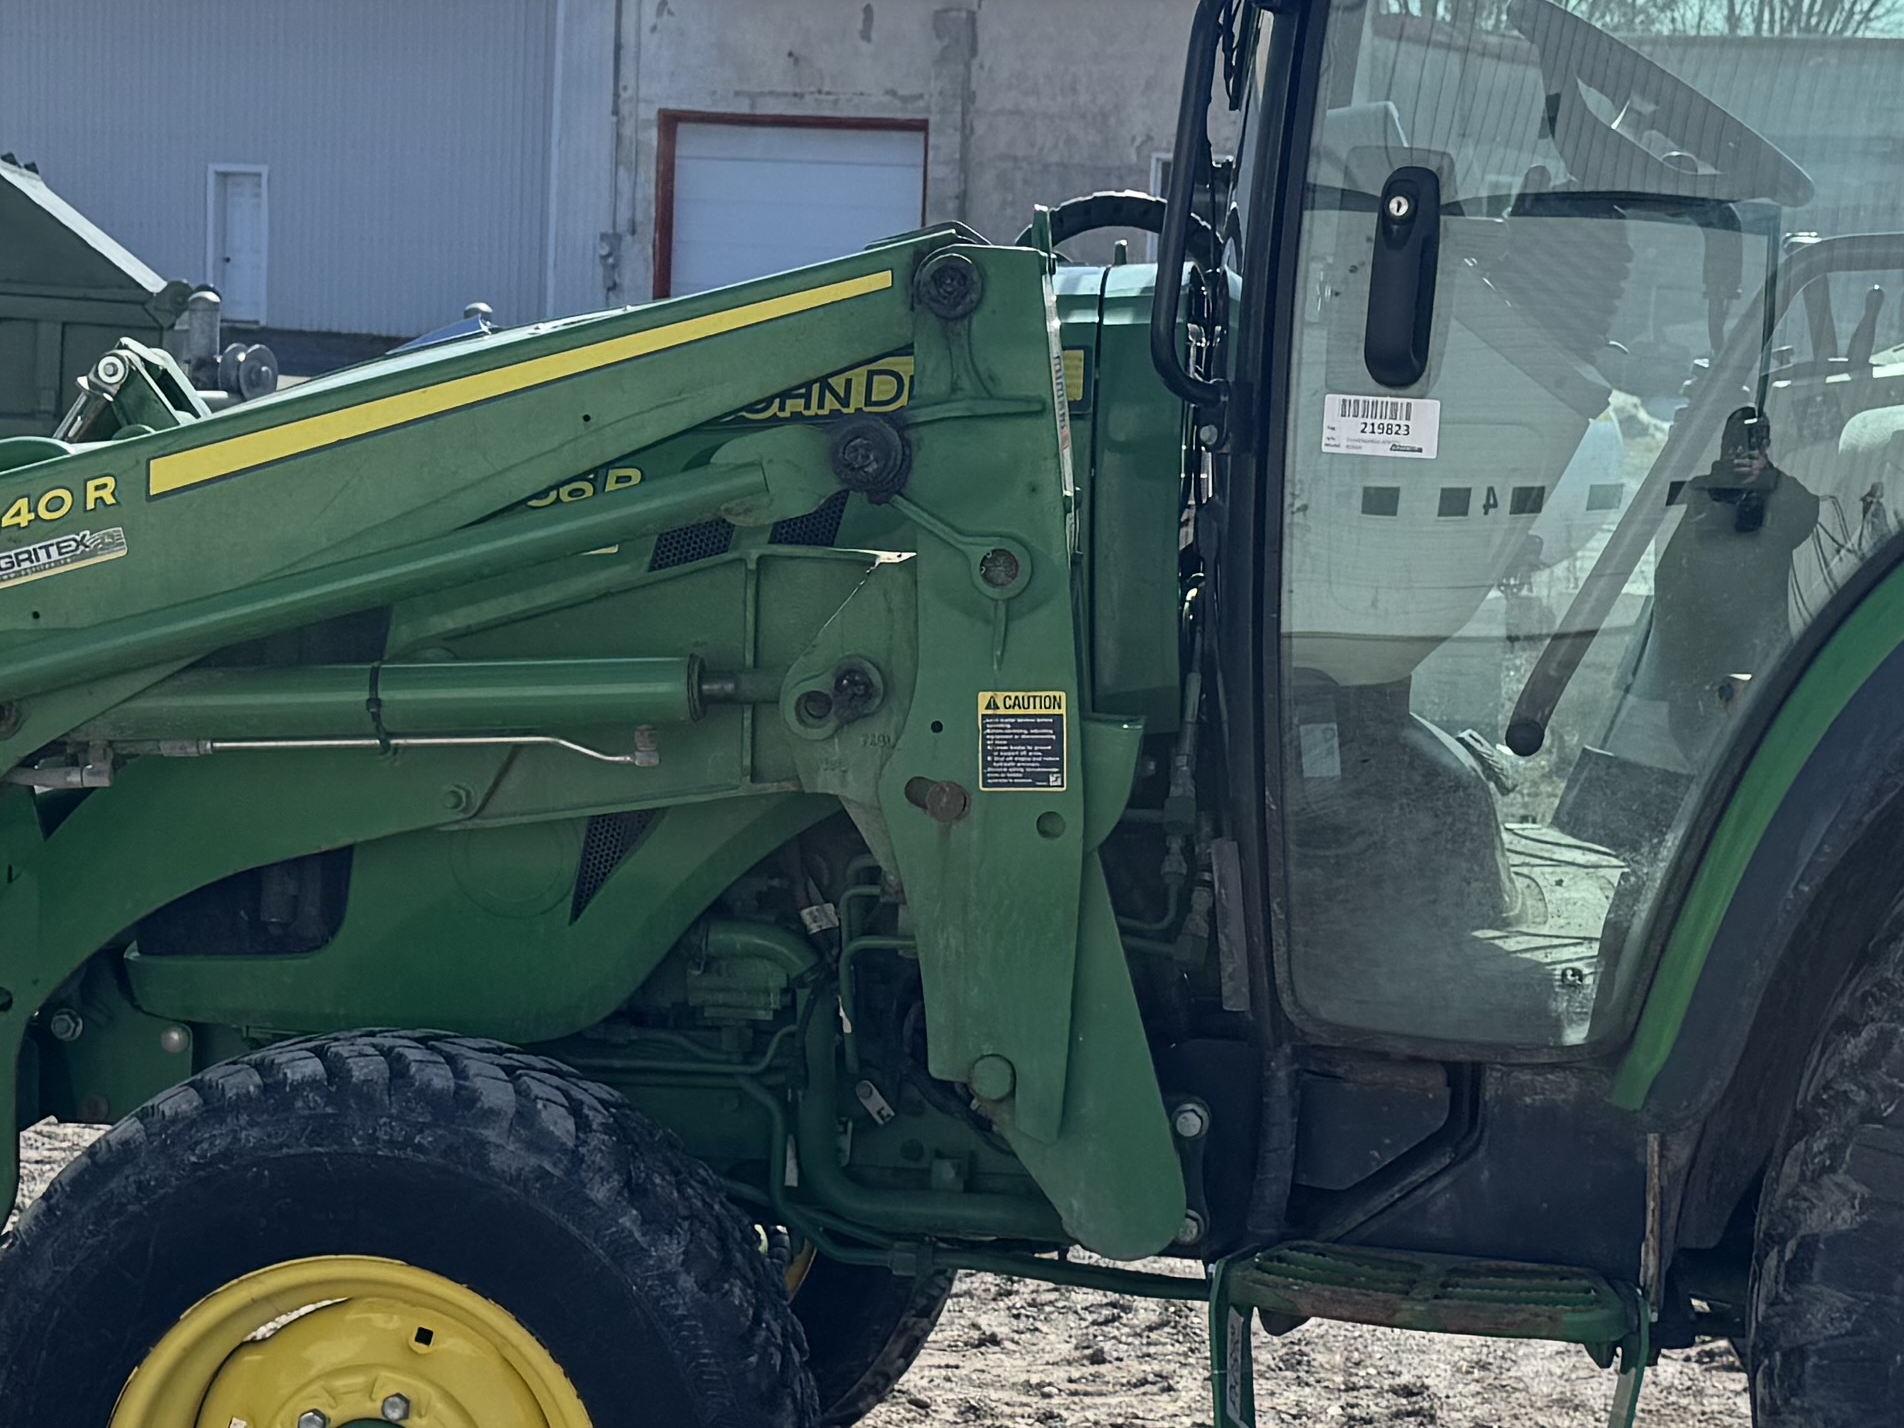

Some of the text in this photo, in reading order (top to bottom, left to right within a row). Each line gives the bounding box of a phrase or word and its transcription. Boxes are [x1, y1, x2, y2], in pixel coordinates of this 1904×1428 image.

[1360, 421, 1411, 436] 219823
[86, 475, 117, 511] R
[1003, 694, 1062, 710] CAUTION
